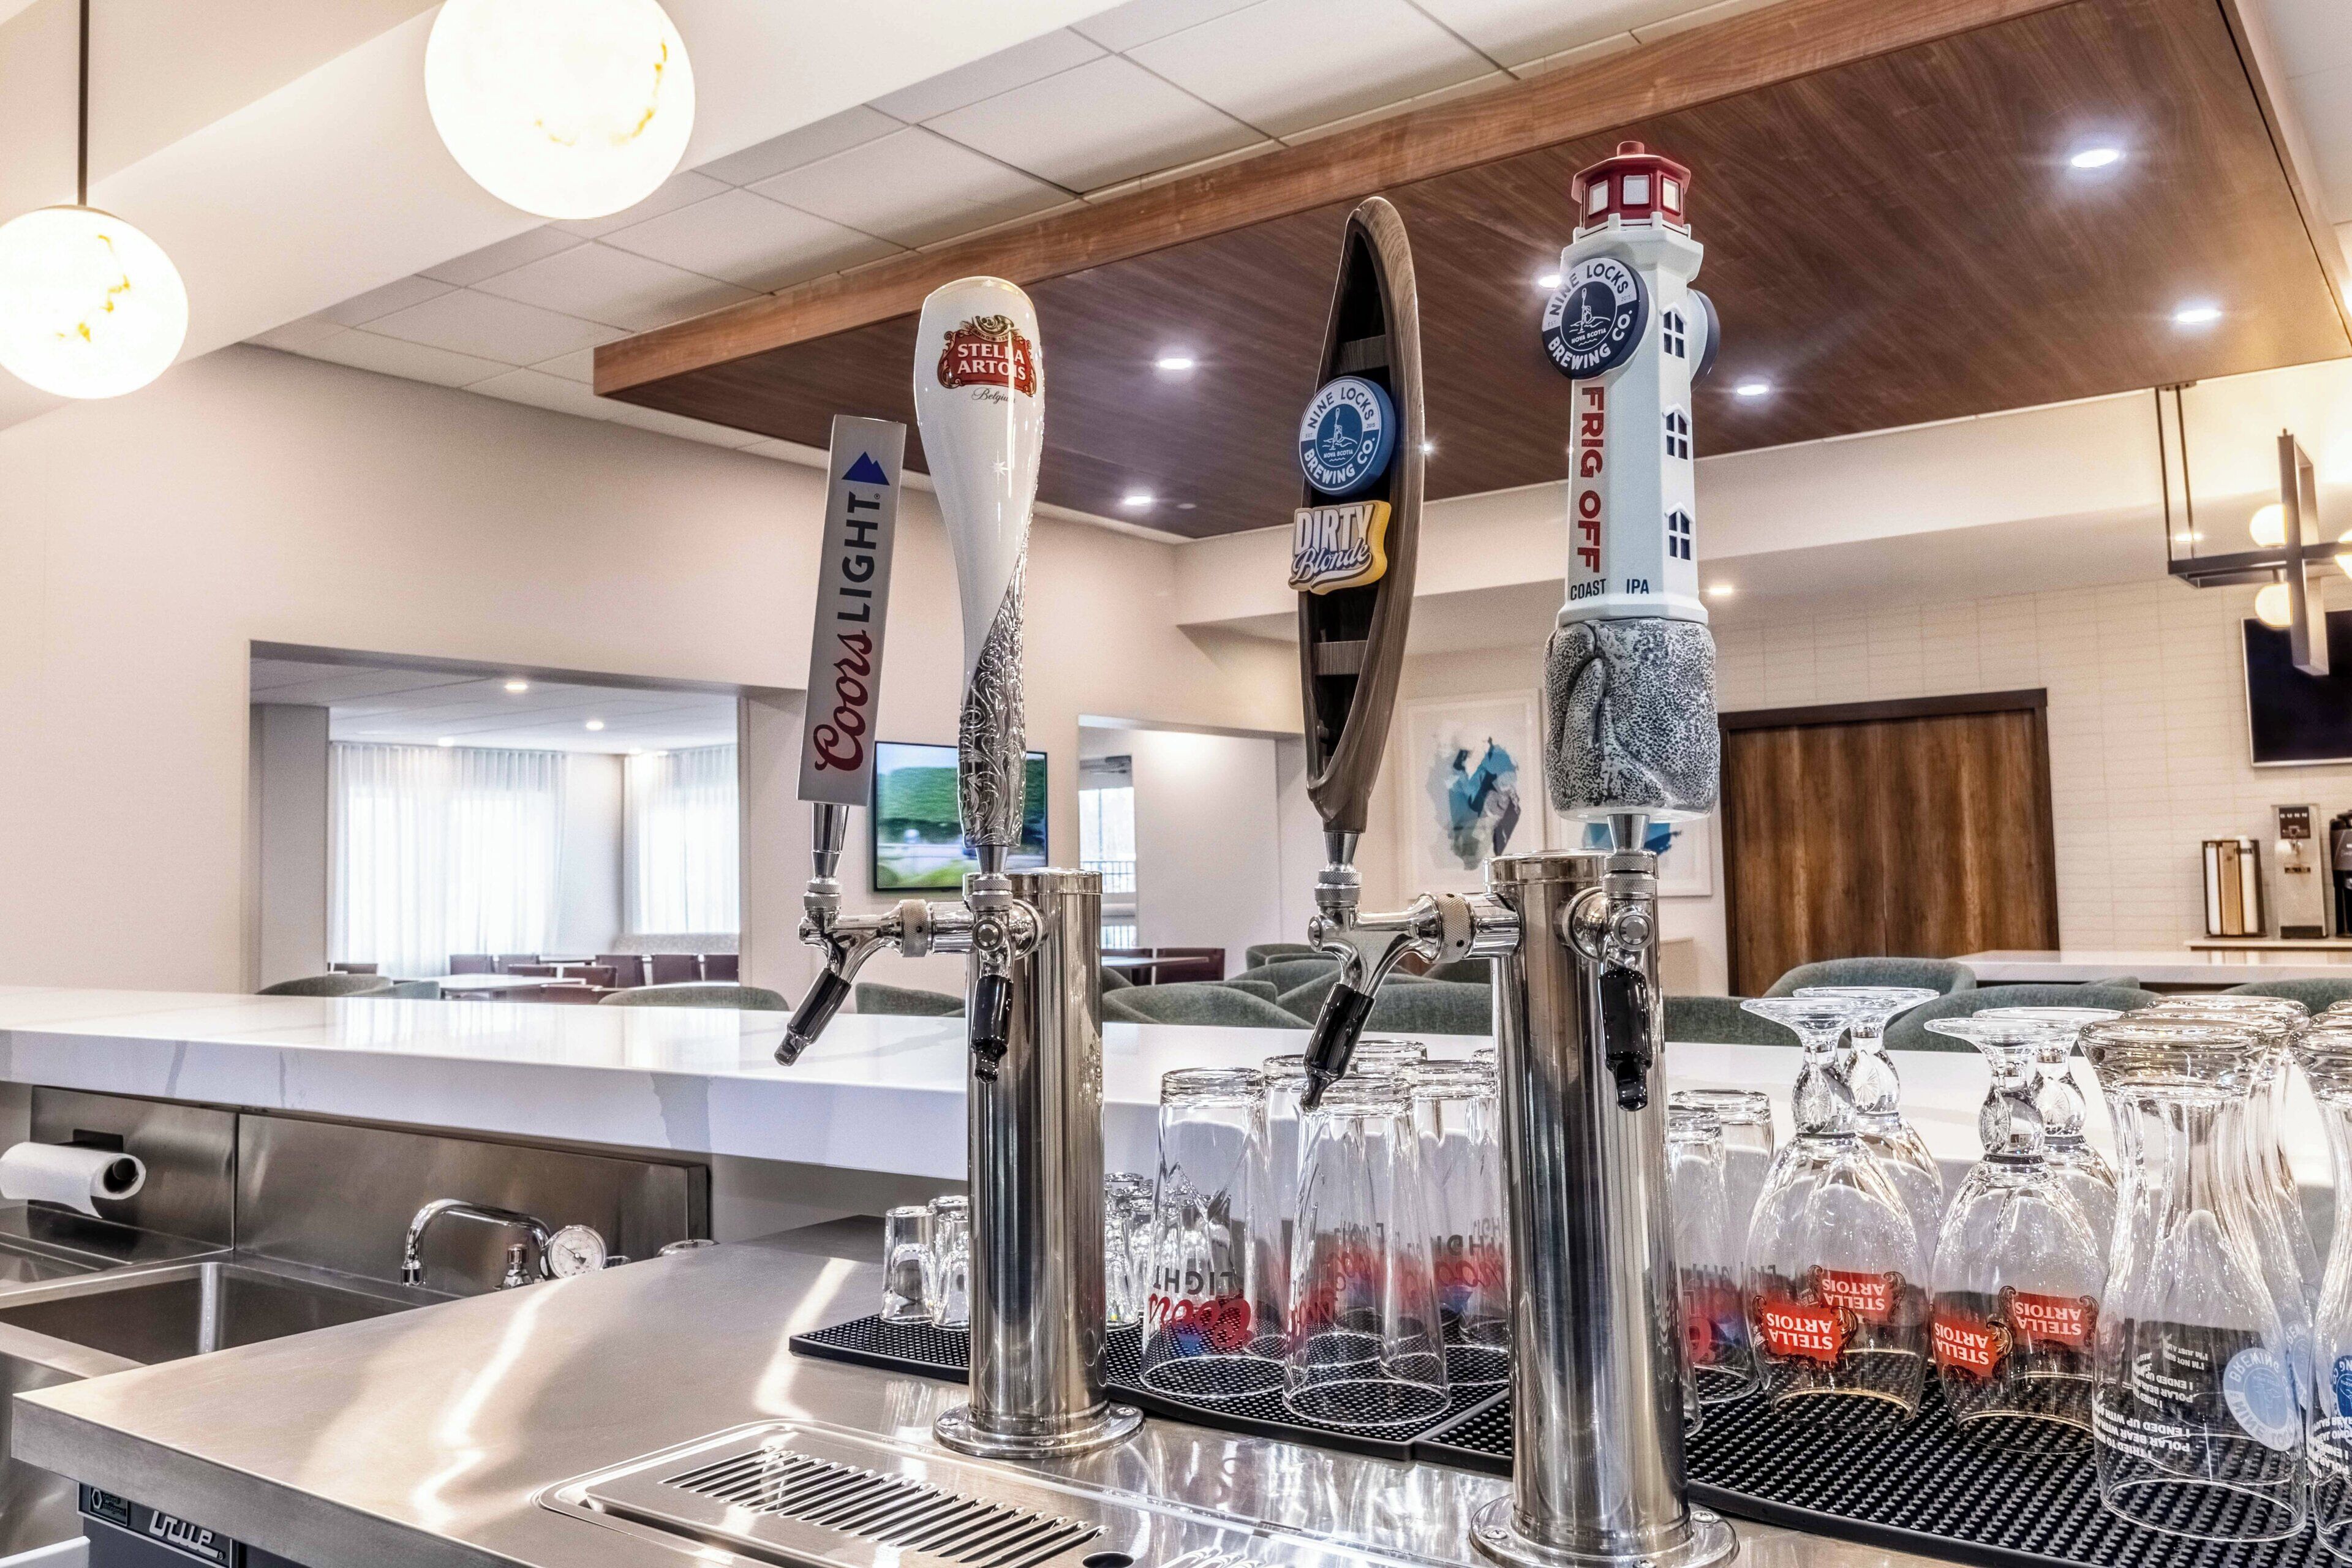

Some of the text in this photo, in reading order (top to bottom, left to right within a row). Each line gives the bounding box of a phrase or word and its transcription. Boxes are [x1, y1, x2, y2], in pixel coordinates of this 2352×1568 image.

[1549, 263, 1629, 316] NINE LOCKS
[1548, 310, 1633, 371] BREWING CO.
[1571, 328, 1607, 344] NOVA SCOTIA
[957, 343, 1025, 365] STELLA
[957, 360, 1027, 381] ARTOIS
[971, 387, 1016, 405] Belgiu
[1307, 386, 1374, 429] NINE LOCKS
[1304, 437, 1376, 484] BREWING CO.
[1577, 386, 1605, 573] FRIG OFF
[1294, 503, 1374, 556] DIRTY
[1291, 537, 1372, 582] Blonde
[1570, 578, 1649, 601] COAST IPA
[813, 491, 880, 772] Coors LIGHT
[1153, 1265, 1234, 1296] LIGHT
[1822, 1278, 1885, 1296] ARTOIS
[1823, 1292, 1885, 1311] STELLA
[1148, 1293, 1254, 1348] Coors
[2014, 1302, 2082, 1321] ARTOIS
[1765, 1313, 1833, 1335] ARTOIS
[2016, 1316, 2082, 1336] STELLA
[1768, 1329, 1833, 1351] STELLA
[1934, 1322, 1989, 1349] ARTOIS
[1935, 1338, 1989, 1365] STELLA
[2177, 1348, 2194, 1357] JUST
[2195, 1351, 2209, 1361] I'M
[2177, 1357, 2191, 1367] NOT
[2192, 1361, 2204, 1370] I'M
[2156, 1374, 2187, 1390] ENDED
[2139, 1392, 2158, 1408] TRIED
[2161, 1388, 2193, 1403] POLAR
[2105, 1409, 2125, 1425] WITH
[2126, 1417, 2141, 1430] UP
[2101, 1421, 2119, 1437] WITH
[2120, 1428, 2147, 1445] BEAR
[2143, 1421, 2184, 1436] ENDED
[2106, 1436, 2117, 1449] TO
[2117, 1441, 2148, 1458] TRIED
[2149, 1439, 2190, 1453] POLAR
